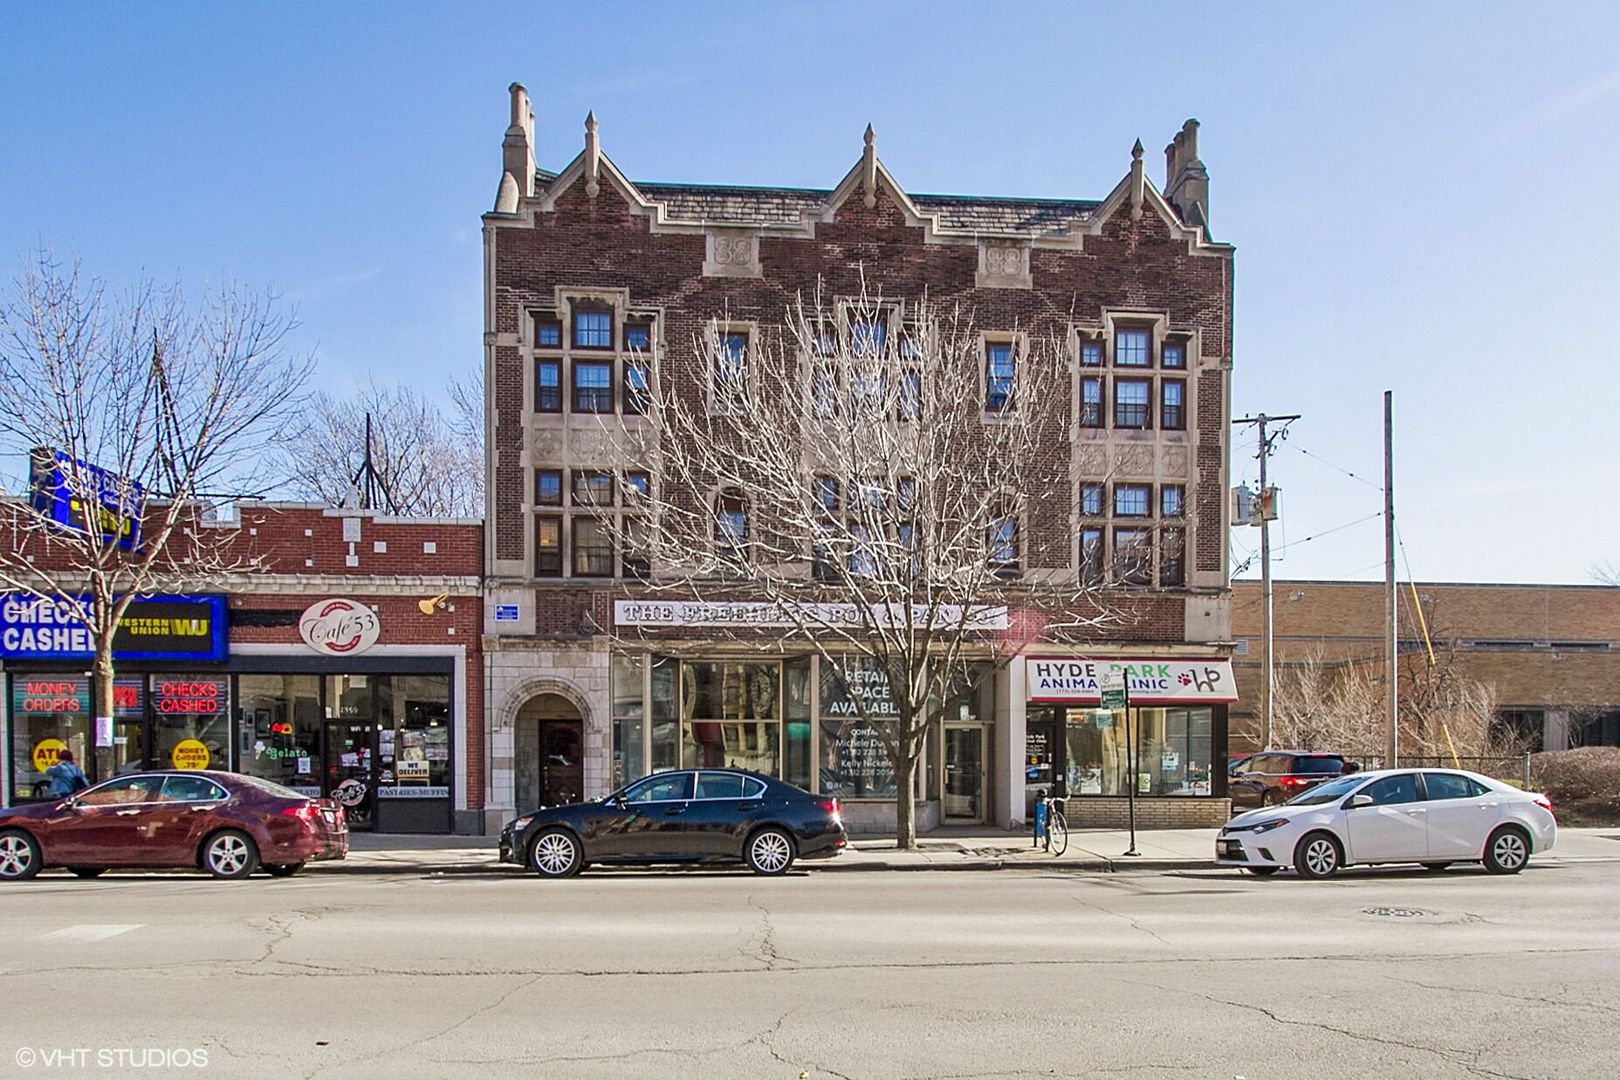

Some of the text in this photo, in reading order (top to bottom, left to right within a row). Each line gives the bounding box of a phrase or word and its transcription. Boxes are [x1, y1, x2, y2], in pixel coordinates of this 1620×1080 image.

[624, 605, 674, 621] THE
[130, 627, 169, 635] UNION
[1037, 663, 1096, 678] HYDE
[27, 682, 76, 696] MONEY
[161, 682, 217, 697] CHECKS
[1040, 678, 1098, 689] ANIMA
[1128, 678, 1168, 690] INIC
[23, 698, 80, 712] ORDERS
[160, 698, 217, 713] CASHED
[830, 702, 900, 714] AVALABL
